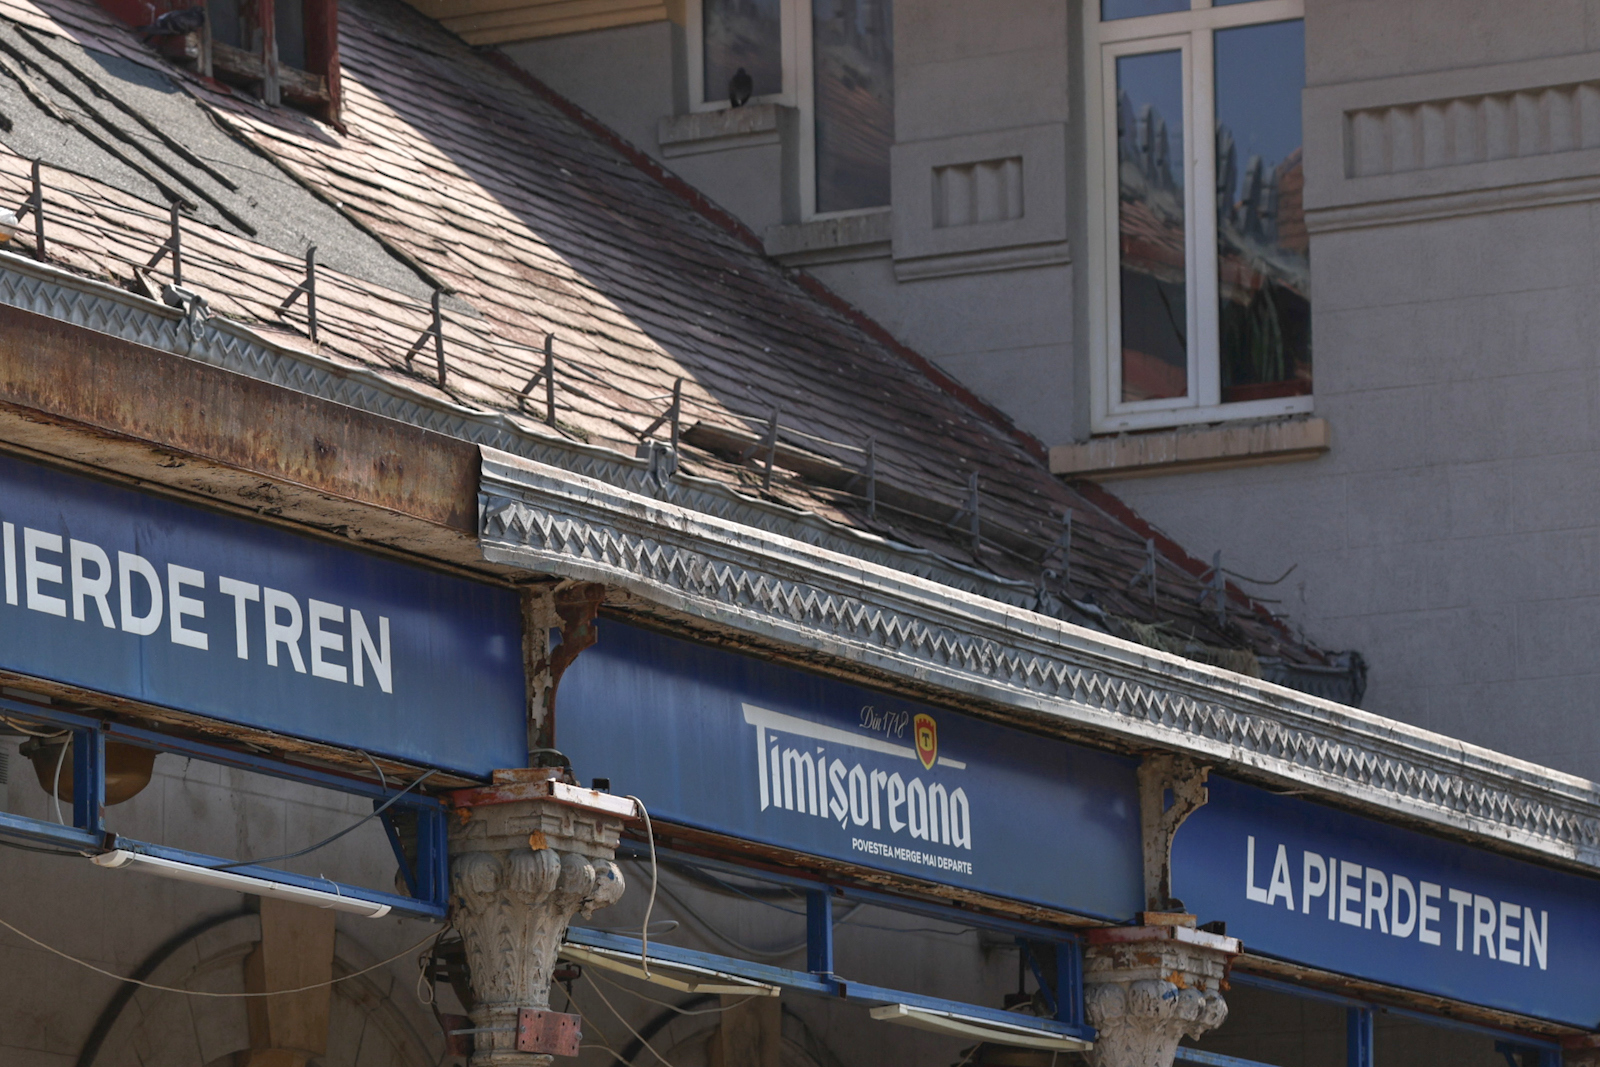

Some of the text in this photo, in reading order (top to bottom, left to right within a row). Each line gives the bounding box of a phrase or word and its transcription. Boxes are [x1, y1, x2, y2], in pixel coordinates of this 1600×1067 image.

[219, 575, 393, 694] TREN
[859, 705, 909, 739] Din 1718
[852, 837, 973, 875] POVESTEA MERGE MAI DEPARTE
[1246, 835, 1548, 971] LA PIERDE TREN
